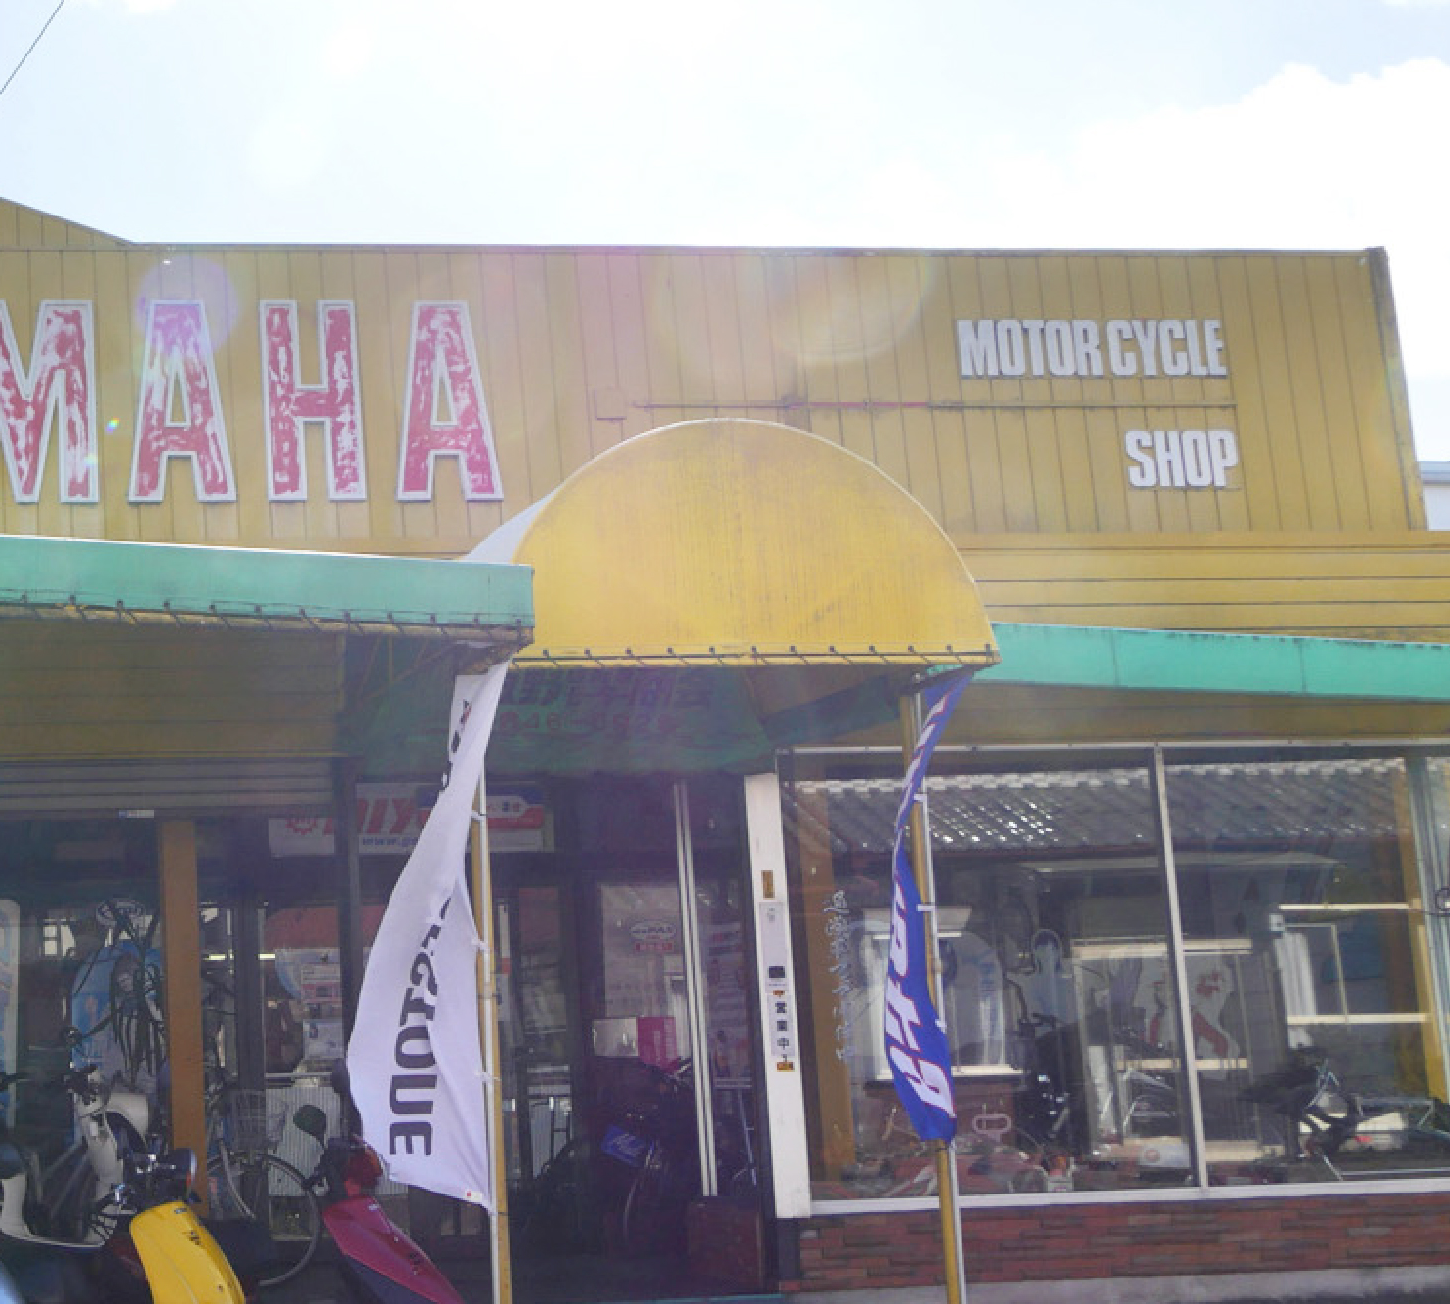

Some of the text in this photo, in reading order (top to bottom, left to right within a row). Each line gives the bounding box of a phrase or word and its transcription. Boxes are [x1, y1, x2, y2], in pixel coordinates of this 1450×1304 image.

[957, 318, 1227, 378] MOTOR CYCLE
[1125, 429, 1238, 488] SHOP
